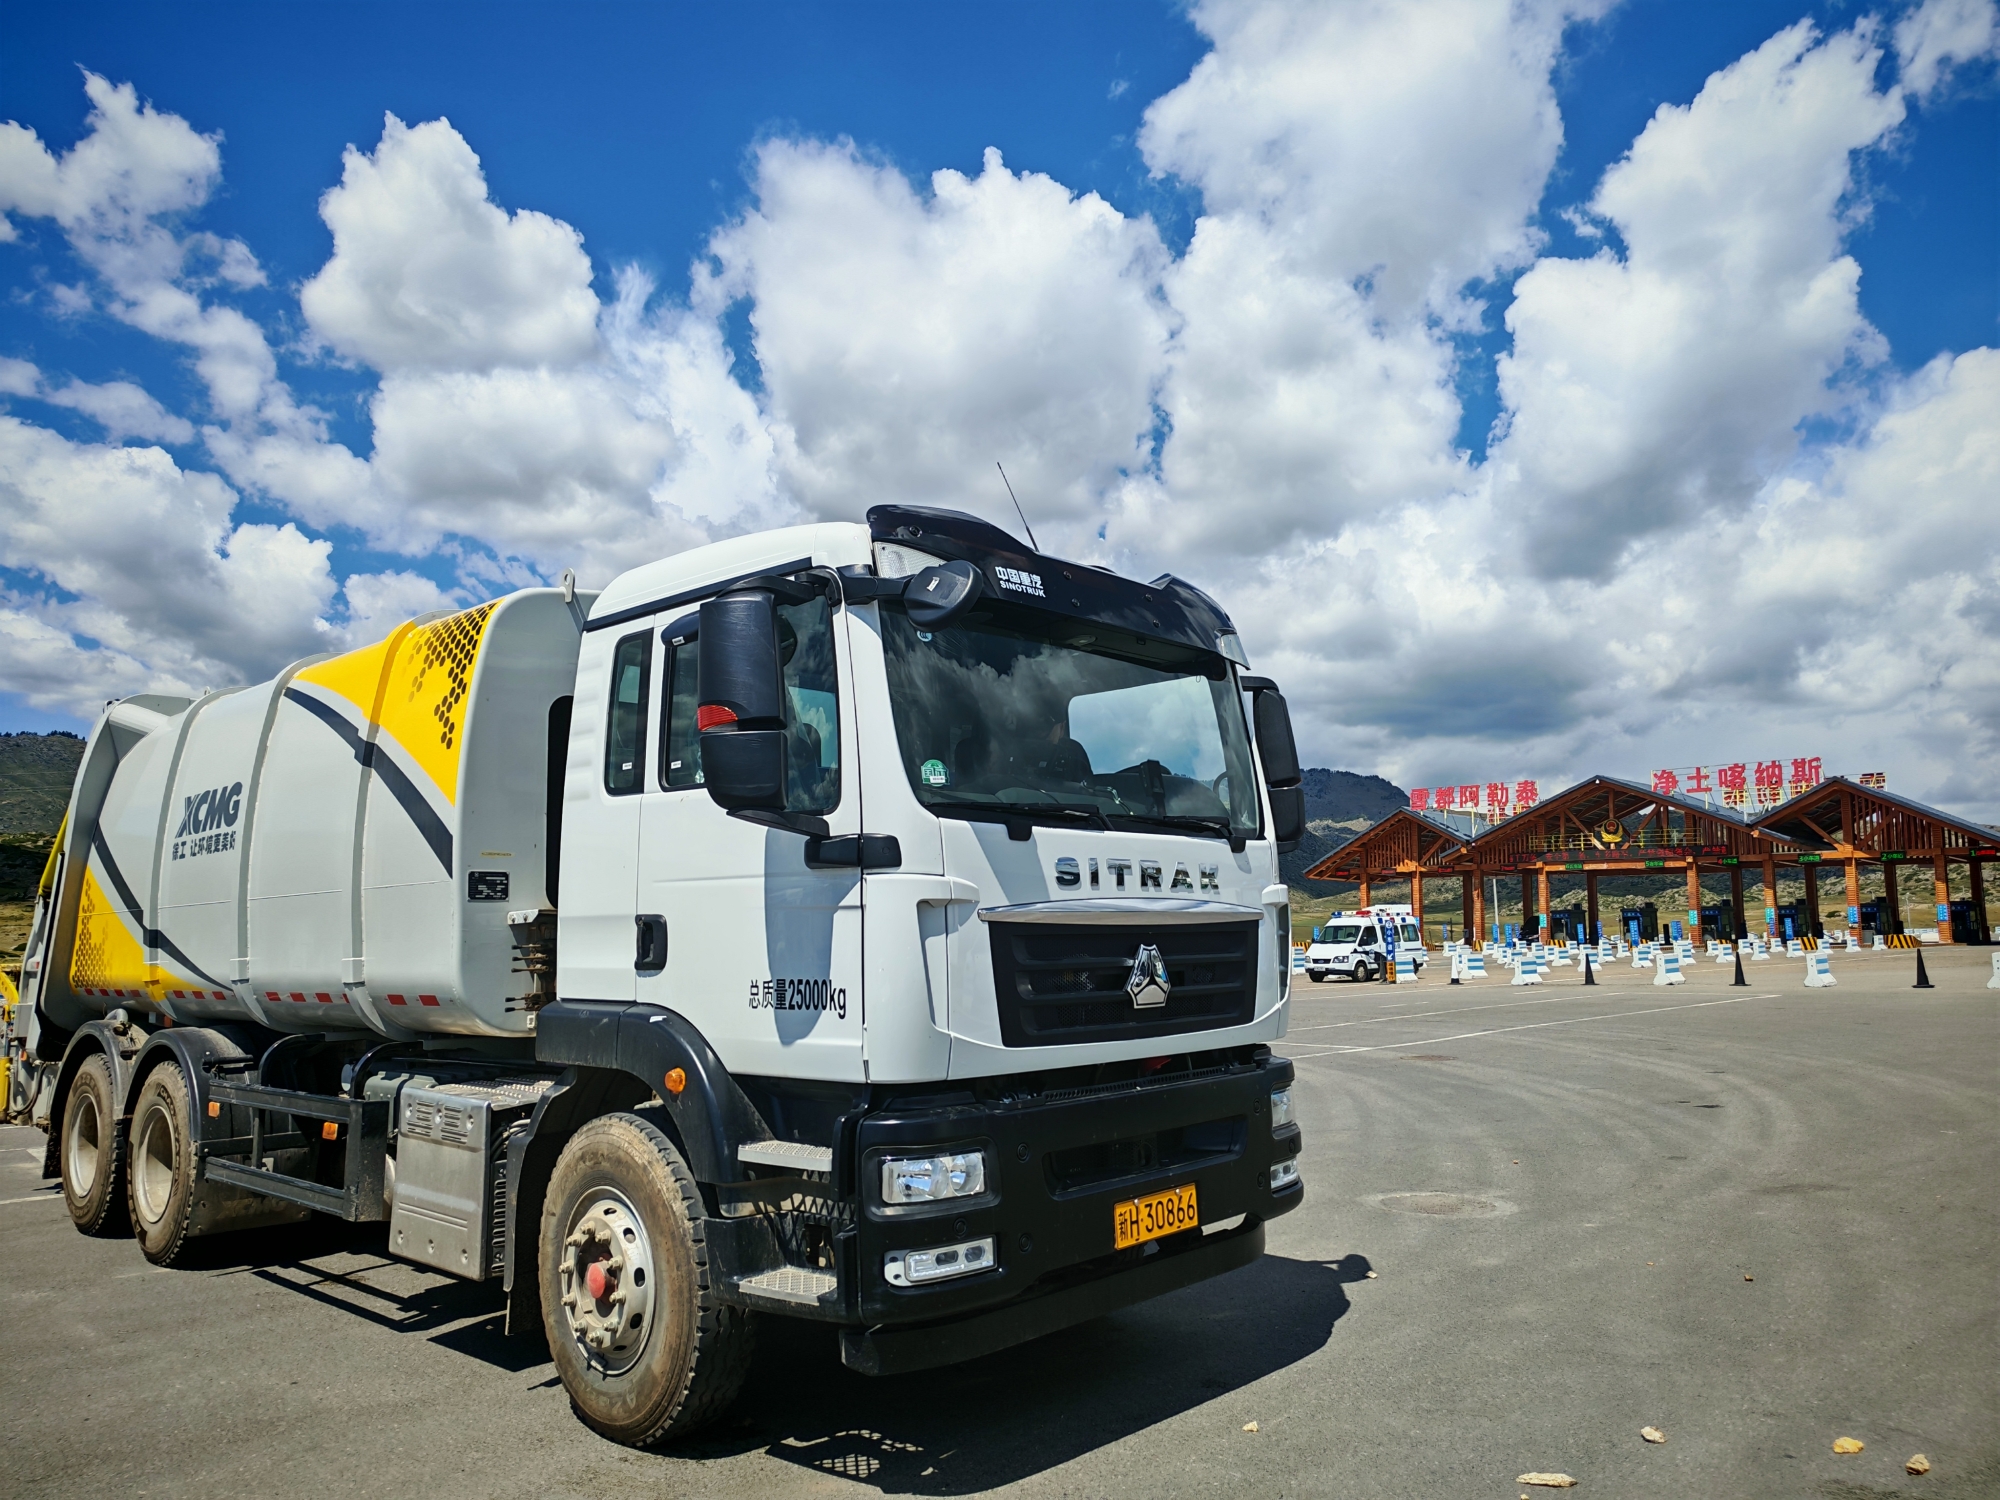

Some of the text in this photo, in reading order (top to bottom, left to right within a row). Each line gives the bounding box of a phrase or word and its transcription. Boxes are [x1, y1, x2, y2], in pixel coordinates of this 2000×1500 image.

[995, 566, 1044, 589] 中国重汽
[1000, 580, 1046, 598] SINOTRUK
[1652, 757, 1822, 795] 净土喀纳斯
[175, 781, 243, 839] XCMG
[1410, 780, 1539, 811] 雪都阿勒泰
[1055, 856, 1219, 890] SITRAK
[749, 978, 847, 1020] 总质量25000kg
